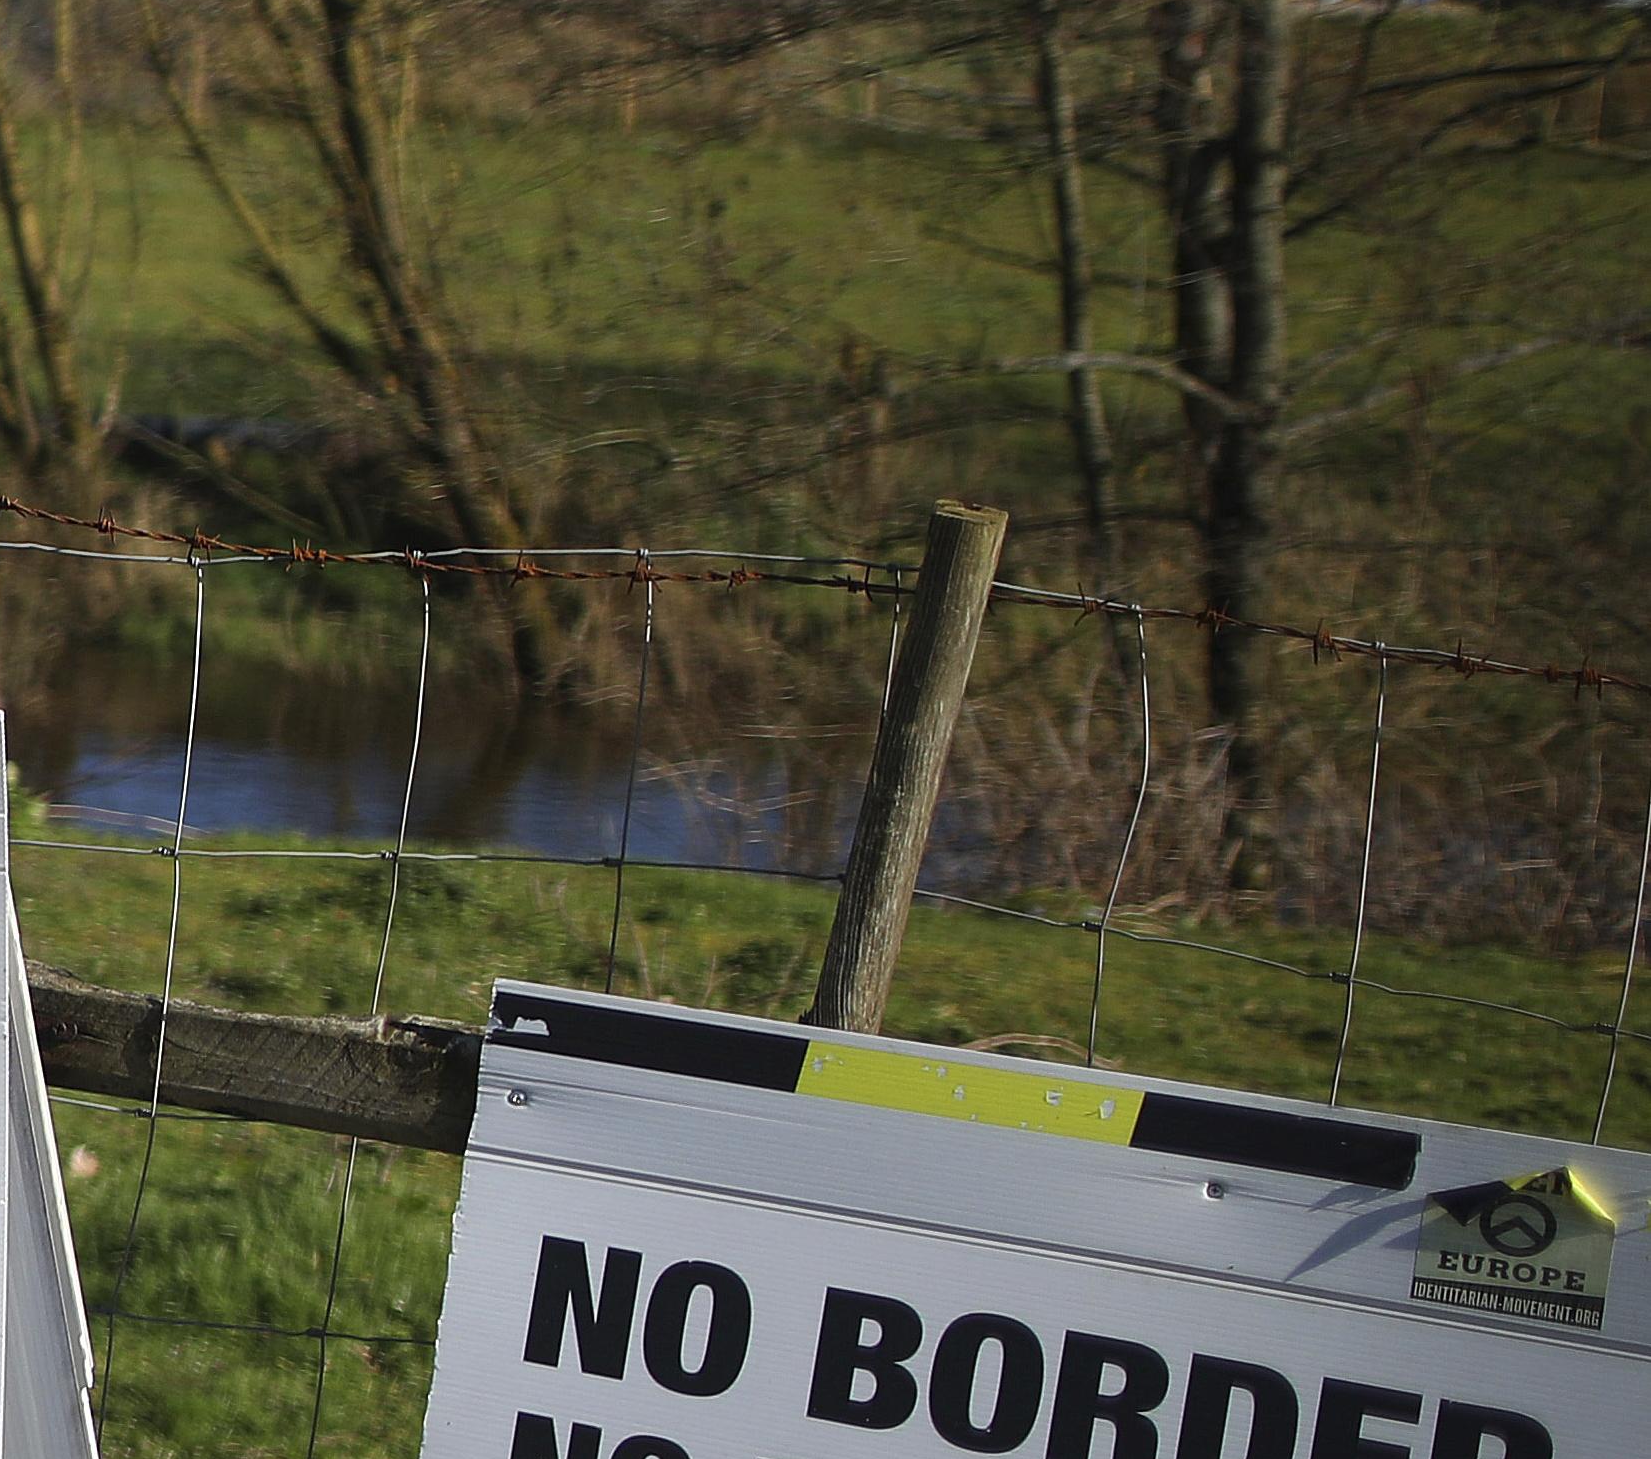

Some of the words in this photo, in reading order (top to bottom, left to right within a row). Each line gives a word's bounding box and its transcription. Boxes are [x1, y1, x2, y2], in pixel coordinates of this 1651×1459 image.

[1437, 1249, 1586, 1292] EUROPE
[523, 1235, 753, 1398] NO
[1413, 1281, 1601, 1327] IDENTITARIAN-MOVEMENT.ORG
